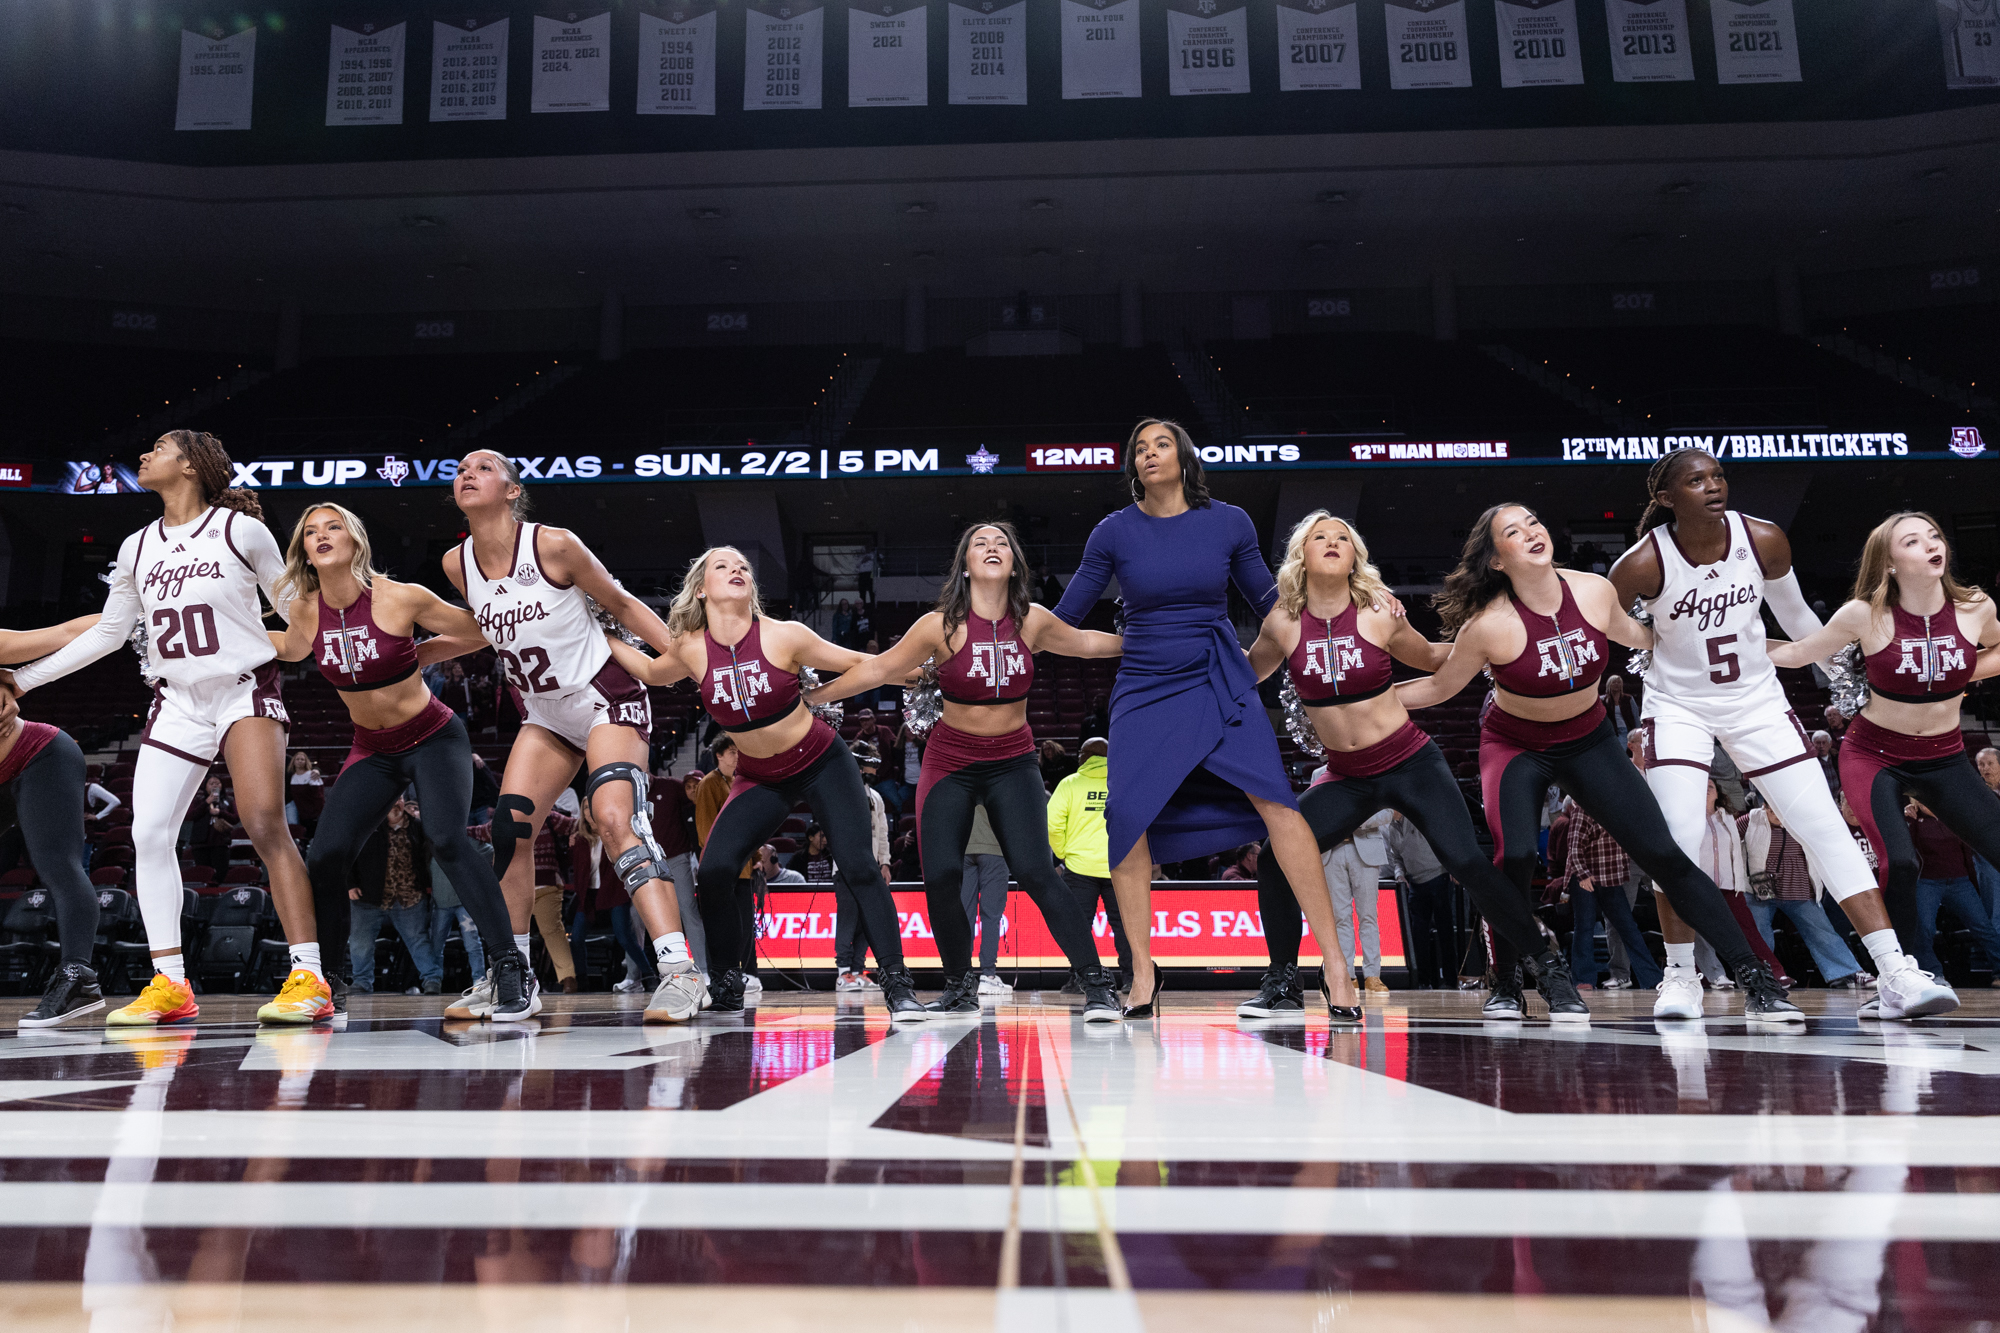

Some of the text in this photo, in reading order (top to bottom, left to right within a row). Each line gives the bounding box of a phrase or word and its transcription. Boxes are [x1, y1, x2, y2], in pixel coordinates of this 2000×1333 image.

[870, 20, 906, 29] SWEET 16
[962, 17, 1013, 26] ELITE EIGHT
[1077, 14, 1124, 23] FINAL FOUR
[1407, 19, 1446, 27] CONFERENCE
[1728, 20, 1778, 28] CHAMPIONSHIP
[658, 28, 687, 36] SWEET
[765, 24, 793, 32] SWEET
[1512, 28, 1565, 36] CHAMPIONSHIP
[1516, 22, 1558, 30] TOURNAMENT
[1622, 24, 1675, 33] CHAMPIONSHIP
[551, 35, 593, 43] APPEARANCES
[970, 31, 1005, 44] 2008
[1085, 27, 1116, 41] 2011
[1292, 33, 1345, 42] CHAMPIONSHIP
[1401, 32, 1454, 40] CHAMPIONSHIP
[1728, 30, 1783, 52] 2021
[1974, 32, 1992, 47] 23
[661, 41, 694, 55] 1994
[767, 36, 801, 50] 2012
[872, 35, 903, 48] 2021
[1182, 38, 1235, 46] CHAMPIONSHIP
[1513, 37, 1567, 60] 2010
[1622, 33, 1677, 56] 2013
[344, 46, 391, 54] APPEARANCES
[575, 47, 600, 59] 2021
[972, 47, 1003, 60] 2011
[1290, 42, 1347, 64] 2007
[1399, 40, 1458, 63] 2008
[368, 58, 392, 69] 1996
[472, 56, 498, 66] 2013
[660, 56, 694, 70] 2008
[767, 52, 801, 66] 2014
[1180, 47, 1236, 69] 1996
[218, 64, 244, 75] 2005
[472, 69, 497, 79] 2015
[766, 68, 800, 81] 2018
[971, 62, 1005, 76] 2014
[368, 72, 394, 82] 2007
[659, 72, 694, 86] 2009
[367, 85, 393, 95] 2009
[472, 82, 496, 93] 2017
[661, 88, 692, 101] 2011
[765, 83, 800, 96] 2019
[368, 98, 392, 109] 2011
[471, 95, 497, 106] 2019
[1308, 300, 1350, 316] 206
[1613, 293, 1654, 309] 207
[112, 311, 158, 330] 202
[707, 314, 748, 329] 204
[1002, 307, 1044, 322] 25
[415, 322, 454, 338] 203
[1951, 427, 1979, 448] 50
[1031, 447, 1116, 467] 12MR
[1193, 444, 1301, 463] OINTS
[1351, 443, 1386, 460] 12TH
[1388, 443, 1434, 459] MAN
[412, 459, 459, 481] VS
[509, 456, 603, 479] XAS
[635, 453, 731, 477] SUN.
[741, 451, 811, 476] 2/2
[839, 450, 864, 474] 5
[875, 448, 939, 472] PM
[0, 467, 23, 481] ALL
[229, 460, 367, 487] XT UP
[518, 564, 535, 580] SEC
[143, 558, 226, 602] Aggies
[1669, 583, 1758, 632] Aggies
[477, 601, 551, 644] Aggies
[152, 603, 221, 660] 20
[1705, 633, 1741, 685] 5
[497, 646, 561, 694] 32
[1086, 791, 1107, 801] BE
[756, 912, 838, 939] WEL
